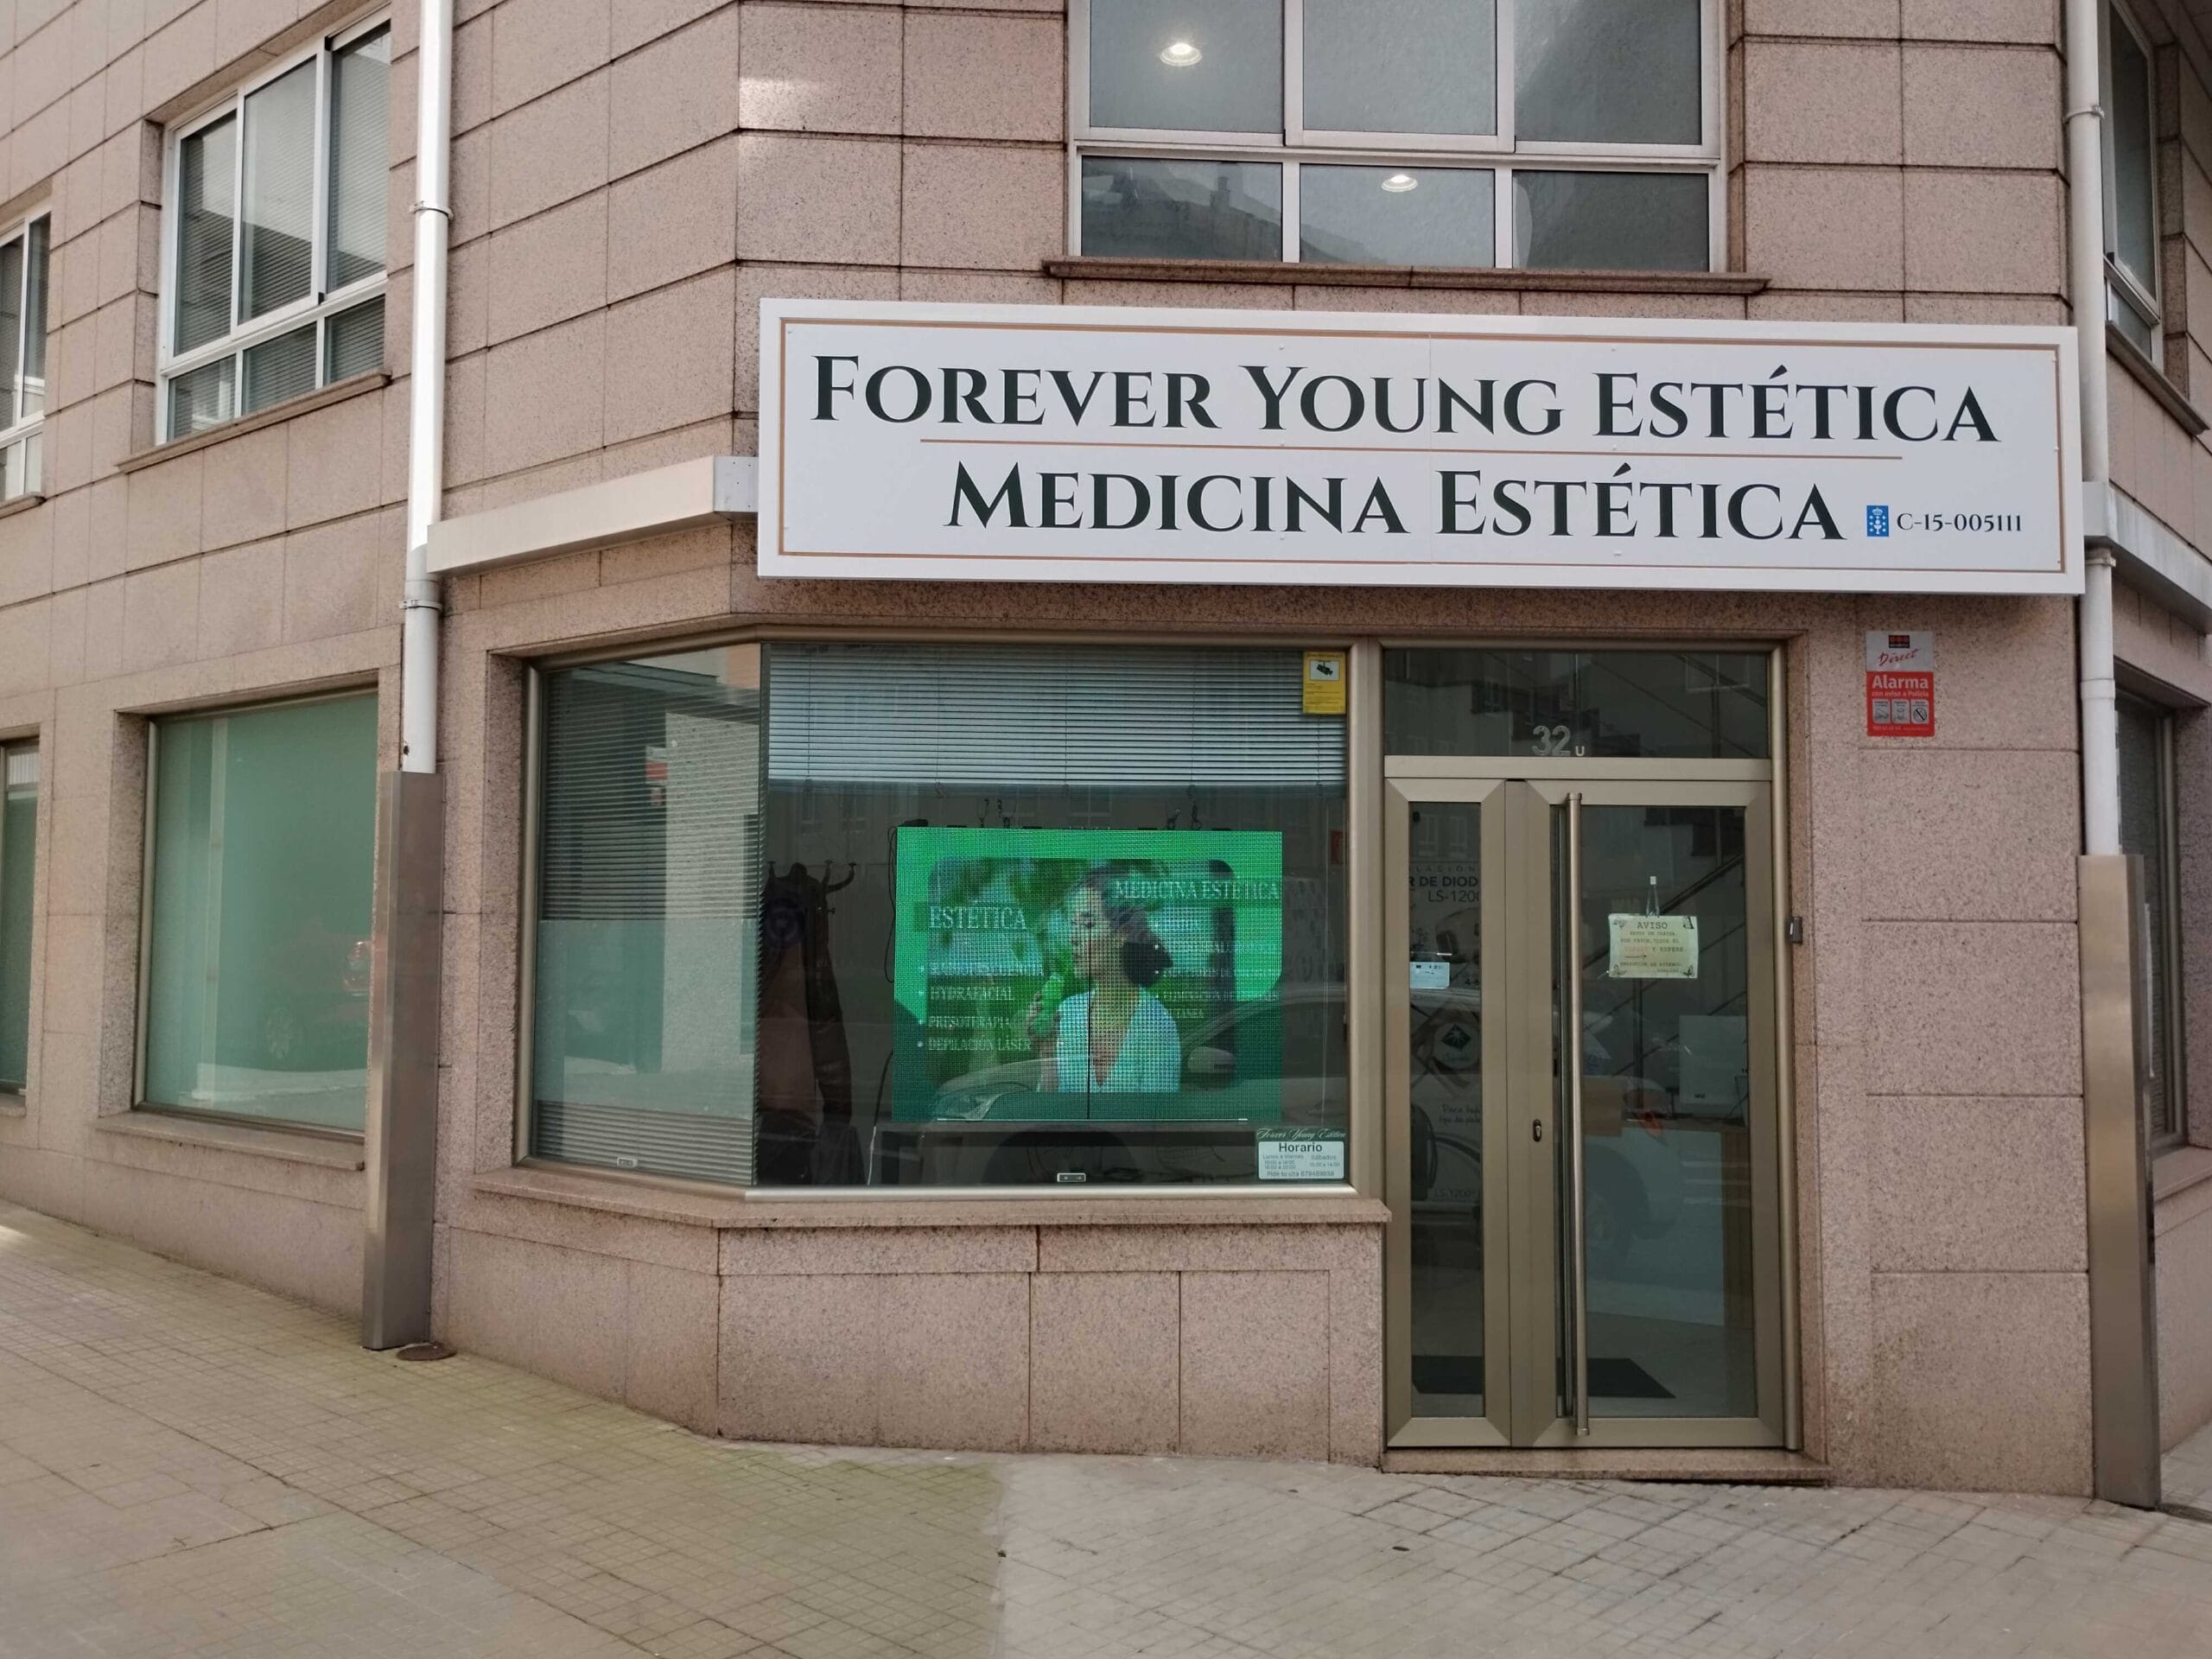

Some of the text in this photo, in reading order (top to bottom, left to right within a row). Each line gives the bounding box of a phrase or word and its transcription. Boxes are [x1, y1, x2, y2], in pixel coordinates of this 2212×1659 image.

[810, 354, 2002, 443] FOREVER YOUNG ESTÉTICA
[944, 461, 1848, 541] MEDICINA ESTÉTICA
[1897, 512, 2022, 532] C-15-005111
[1878, 648, 1922, 666] Direct
[1872, 675, 1929, 689] Alarma
[1532, 726, 1570, 755] 32
[1115, 880, 1198, 899] MEDICINA
[1419, 876, 1438, 887] DE
[1279, 1142, 1323, 1152] Horario
